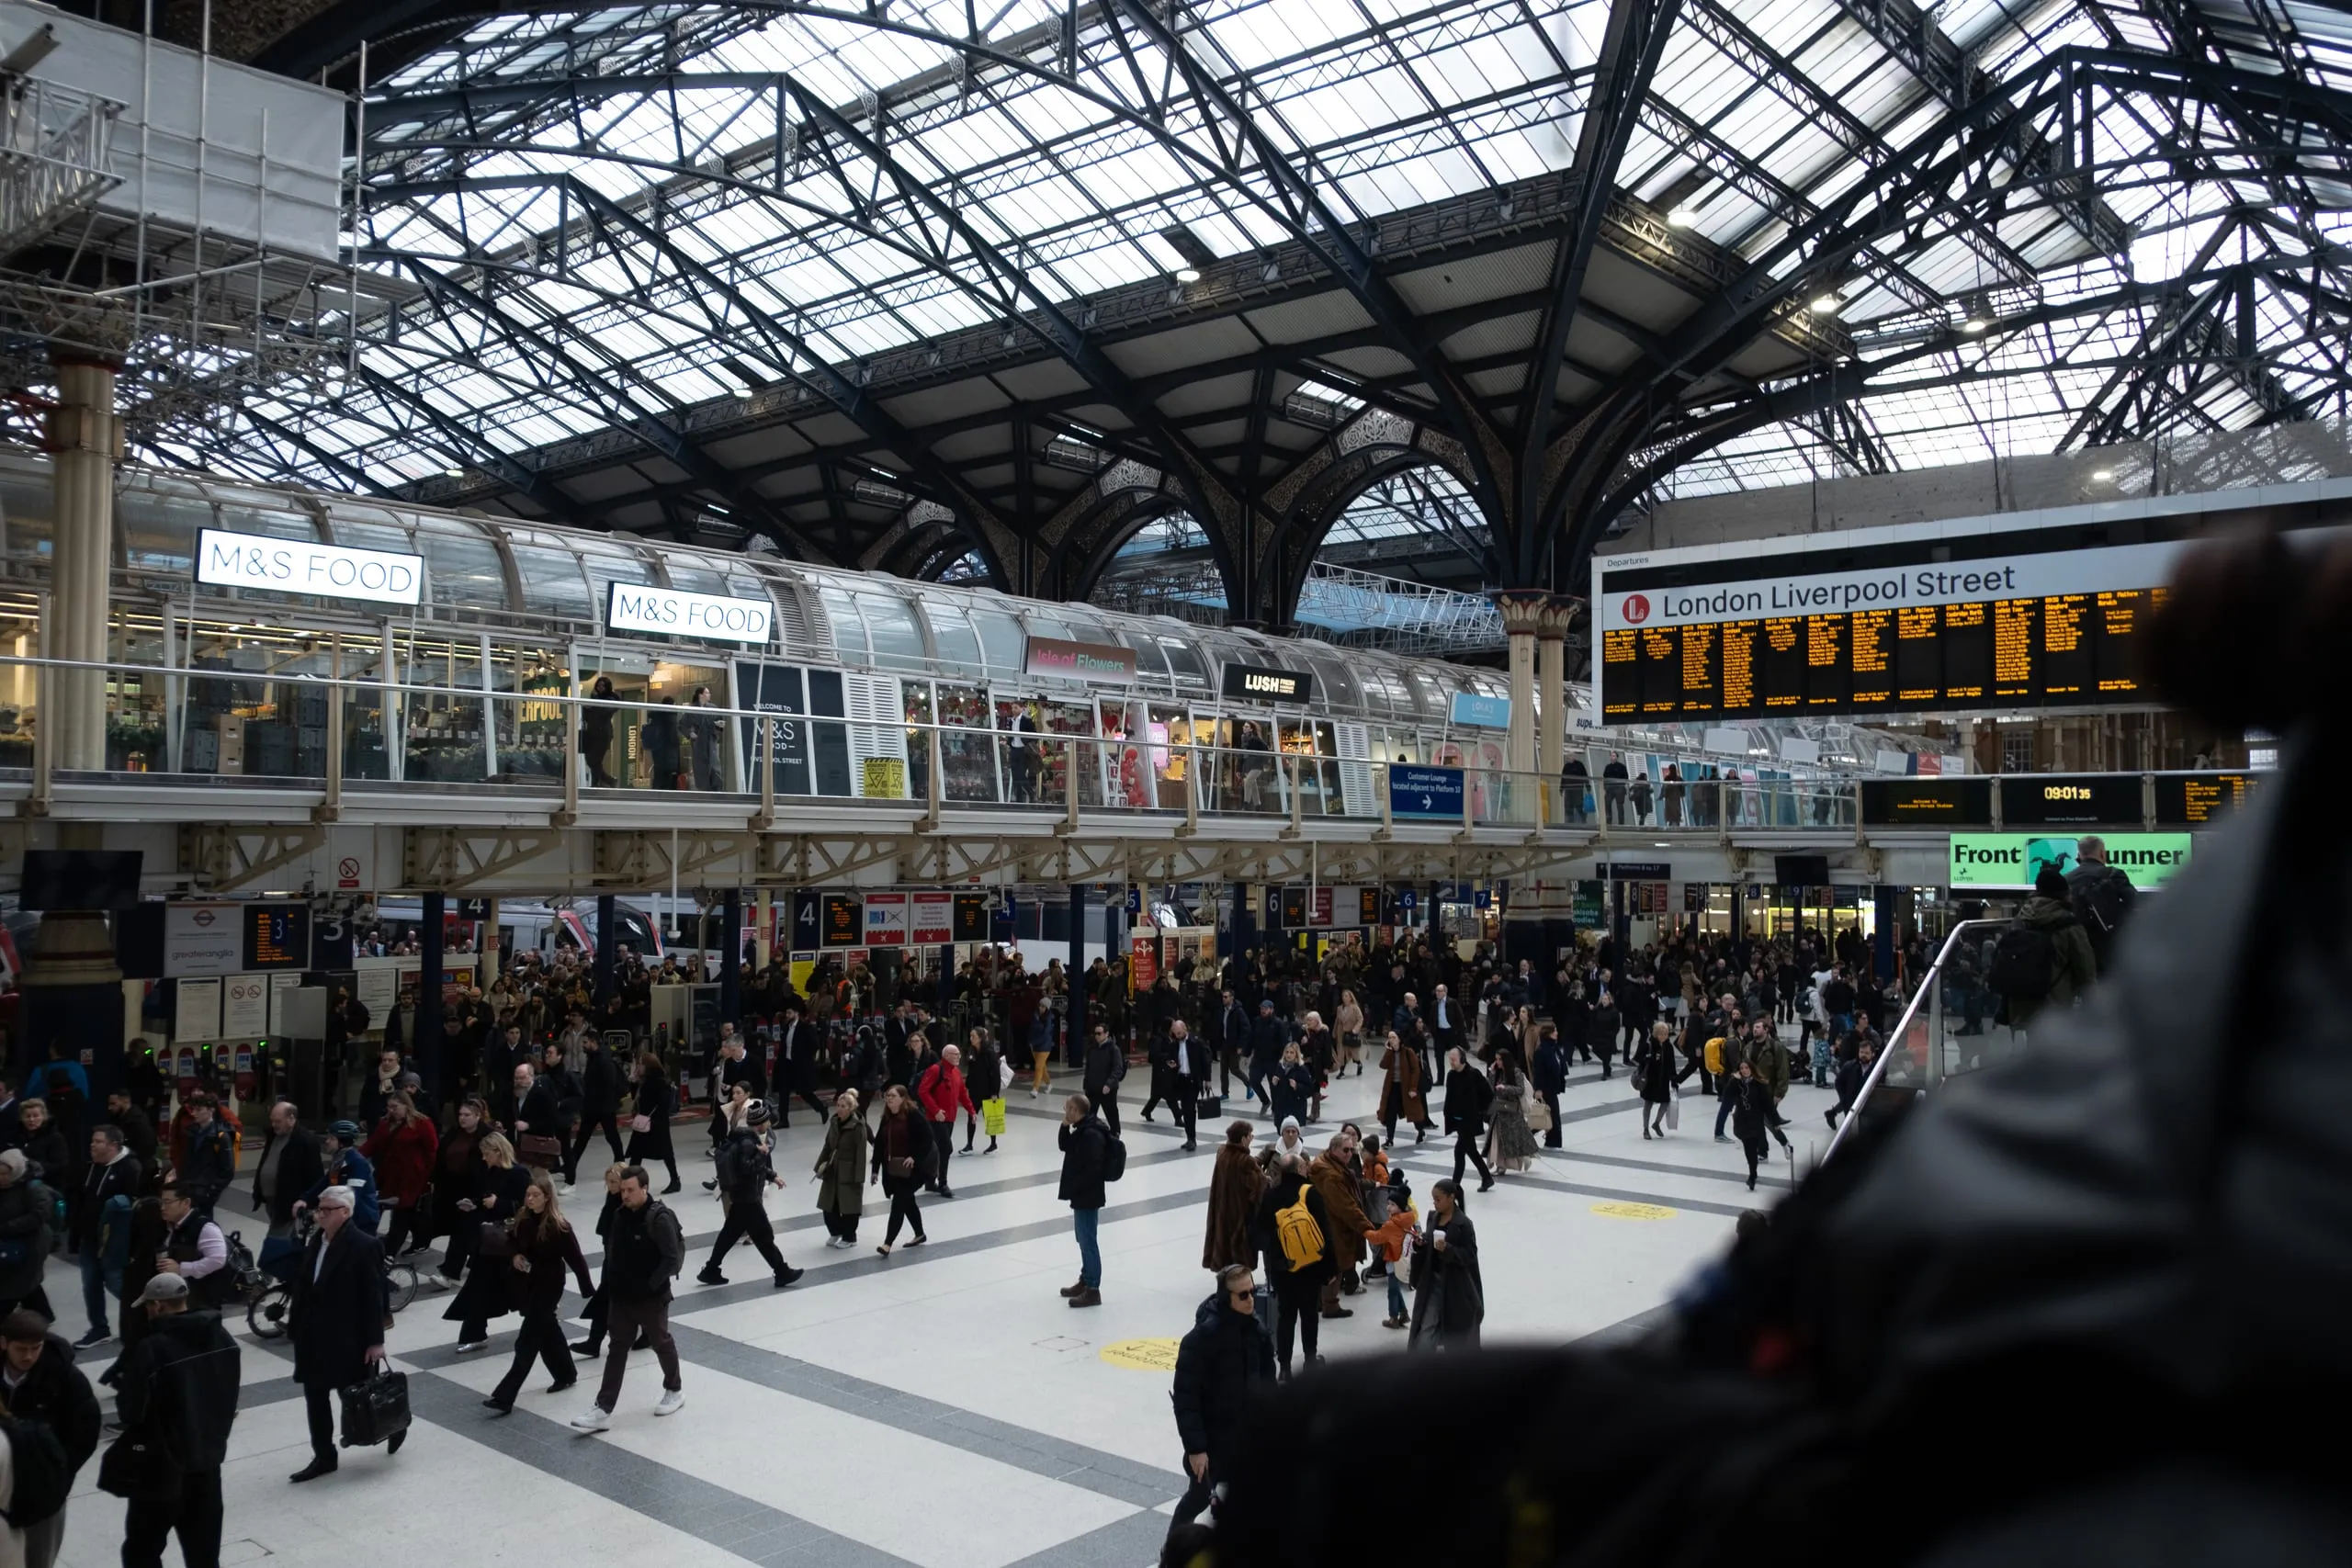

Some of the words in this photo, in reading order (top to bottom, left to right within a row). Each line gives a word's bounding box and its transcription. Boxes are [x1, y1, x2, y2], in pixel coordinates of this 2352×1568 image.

[212, 543, 291, 580] M&S
[308, 555, 412, 592] FOOD
[1607, 557, 1649, 568] Departures
[1664, 588, 1762, 618] London
[1771, 572, 1906, 610] Liverpool
[1916, 565, 2016, 597] Street
[619, 594, 678, 624] M&S
[688, 603, 764, 633] FOOD
[1037, 649, 1058, 663] Isle
[1061, 652, 1077, 668] of
[1077, 654, 1125, 673] Flowers
[1245, 673, 1280, 694] LUSH
[784, 705, 792, 713] TO
[628, 725, 637, 760] LONDON
[782, 757, 802, 765] STREET
[1408, 771, 1430, 782] Customer
[1430, 773, 1447, 784] Lounge
[1392, 781, 1409, 792] located
[1410, 782, 1430, 793] adjacent
[1430, 784, 1436, 793] to
[1436, 783, 1455, 794] Platform
[1455, 785, 1461, 794] 10
[2044, 786, 2077, 800] 09:01
[2078, 788, 2091, 800] 35
[1954, 844, 2022, 864] Front
[2106, 849, 2183, 865] unner
[1169, 884, 1177, 900] 7
[1571, 880, 1578, 892] 10
[1792, 887, 1800, 896] 9
[1129, 893, 1136, 908] 5
[1404, 893, 1412, 906] 6
[1479, 893, 1486, 906] 7
[1632, 887, 1637, 901] 8
[468, 897, 483, 914] 4
[1270, 893, 1278, 912] 6
[799, 901, 816, 926] 4
[275, 918, 283, 941] 3
[322, 921, 344, 942] 3
[172, 948, 234, 961] greateranglia
